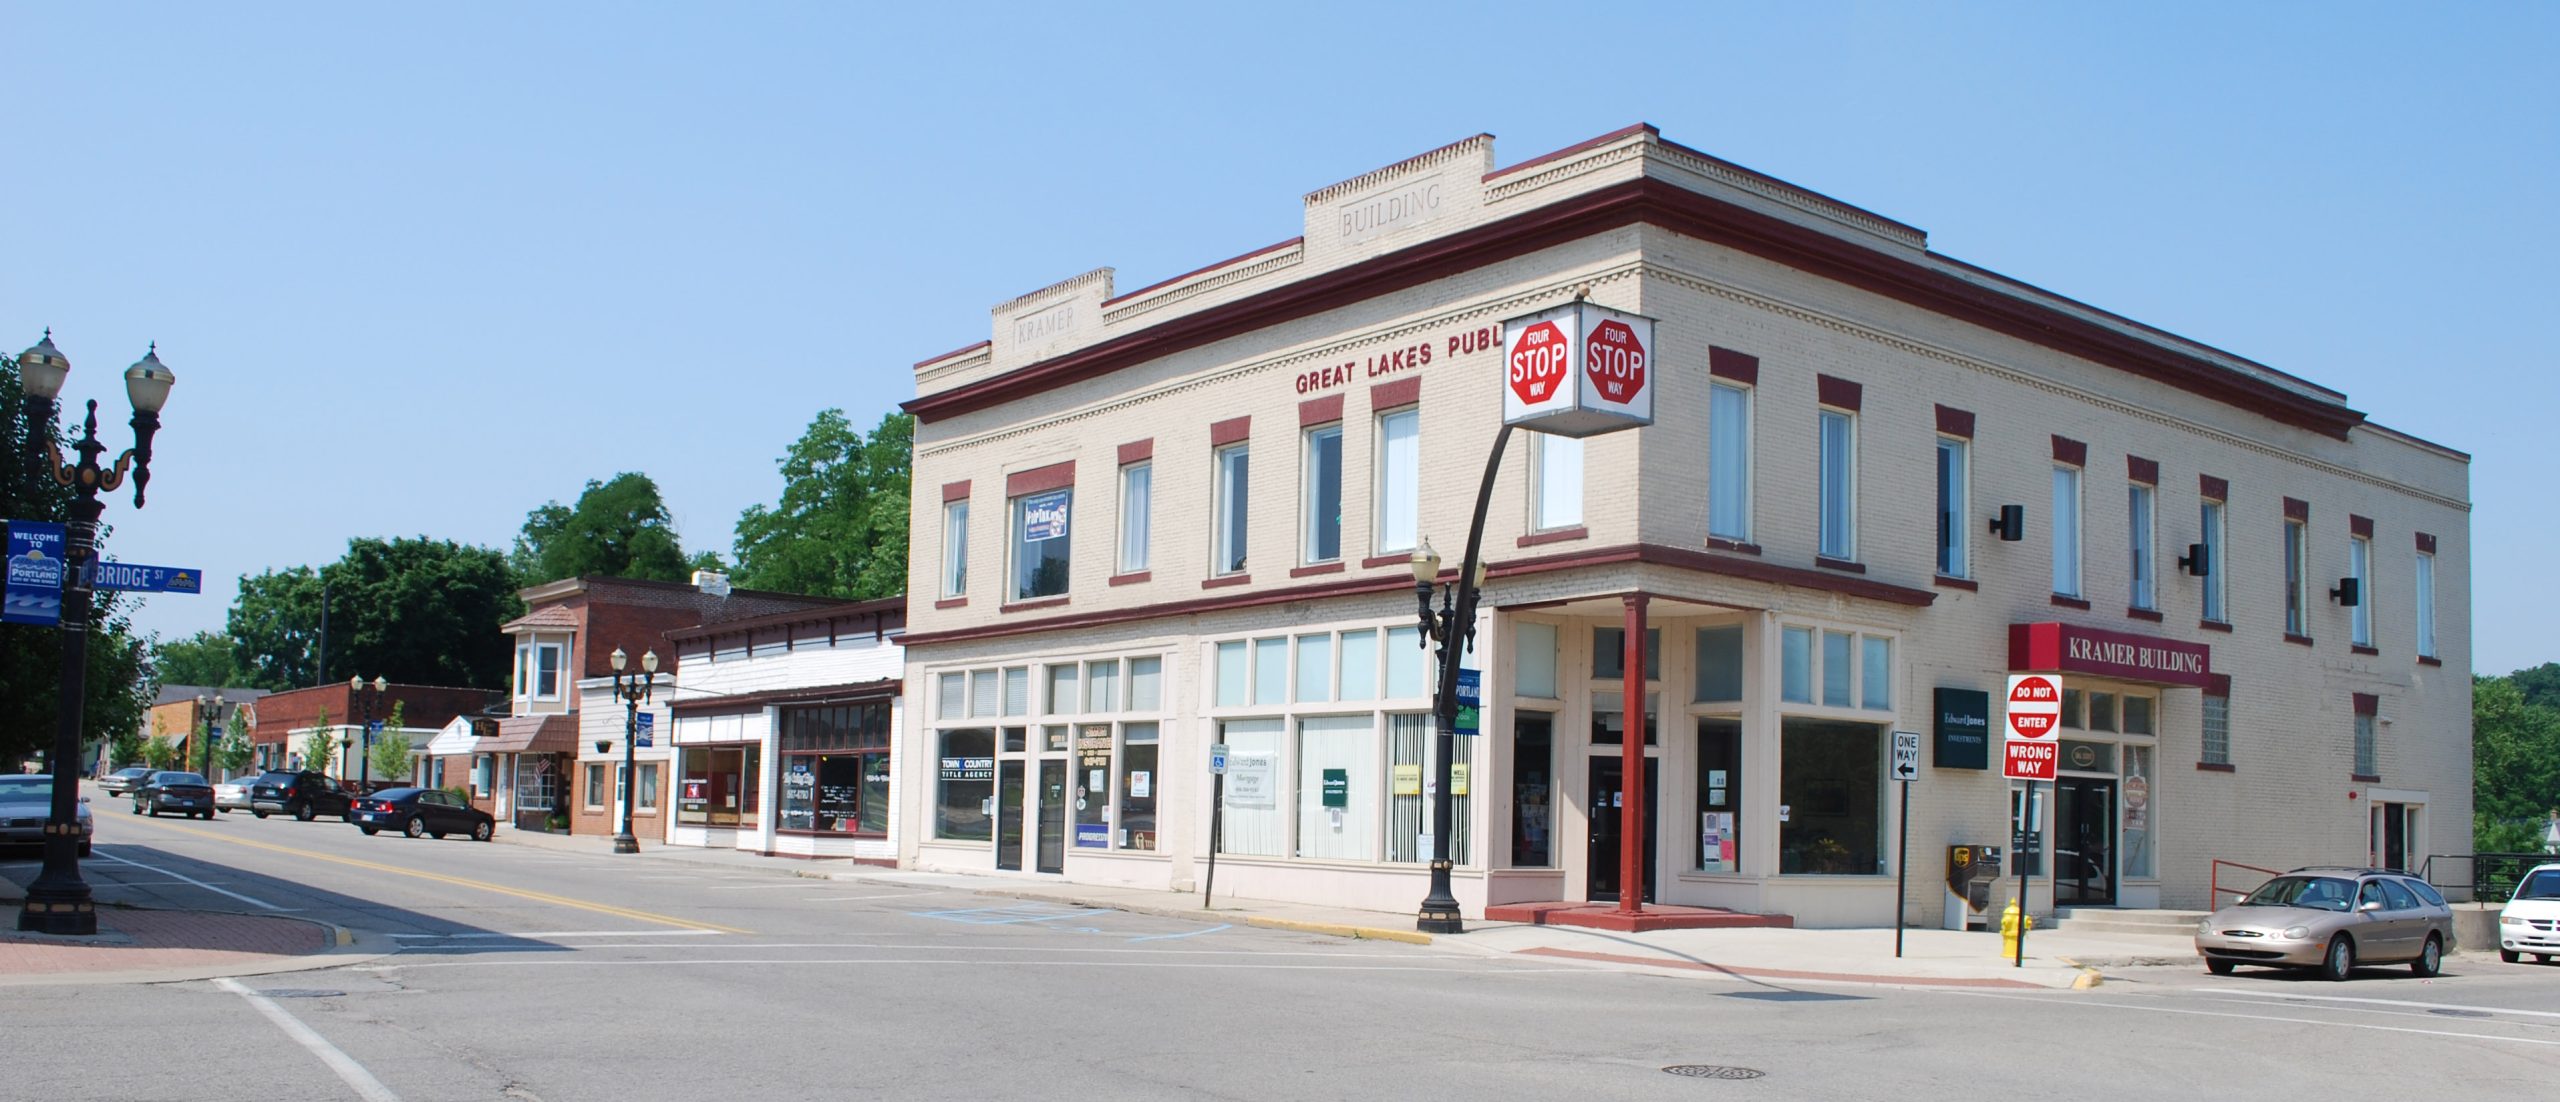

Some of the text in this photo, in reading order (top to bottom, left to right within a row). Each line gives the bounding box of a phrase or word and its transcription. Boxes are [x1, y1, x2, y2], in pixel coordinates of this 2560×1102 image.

[1343, 183, 1440, 237] BUILDING
[1018, 306, 1074, 344] KRAMER
[1527, 328, 1549, 346] FOUR
[1605, 327, 1627, 344] FOUR
[1296, 362, 1355, 394] GREAT
[1368, 343, 1431, 377] LAKES
[1512, 343, 1565, 383] STOP
[1589, 342, 1643, 380] STOP
[1530, 381, 1545, 397] WAY
[1607, 381, 1623, 396] WAY
[13, 532, 60, 542] WELCOME
[30, 540, 43, 548] TO
[12, 568, 58, 580] PORTLAND
[95, 565, 151, 588] BRIDGE
[154, 569, 164, 580] ST
[2069, 637, 2202, 674] KRAMER BUILDING
[2017, 687, 2052, 698] DO NOT
[2017, 716, 2048, 729] ENTER
[1897, 735, 1917, 748] ONE
[1896, 749, 1917, 761] WAY
[2009, 745, 2052, 760] WRONG
[942, 760, 960, 768] TOWN
[964, 760, 993, 769] COUNTRY
[2017, 760, 2042, 774] WAY
